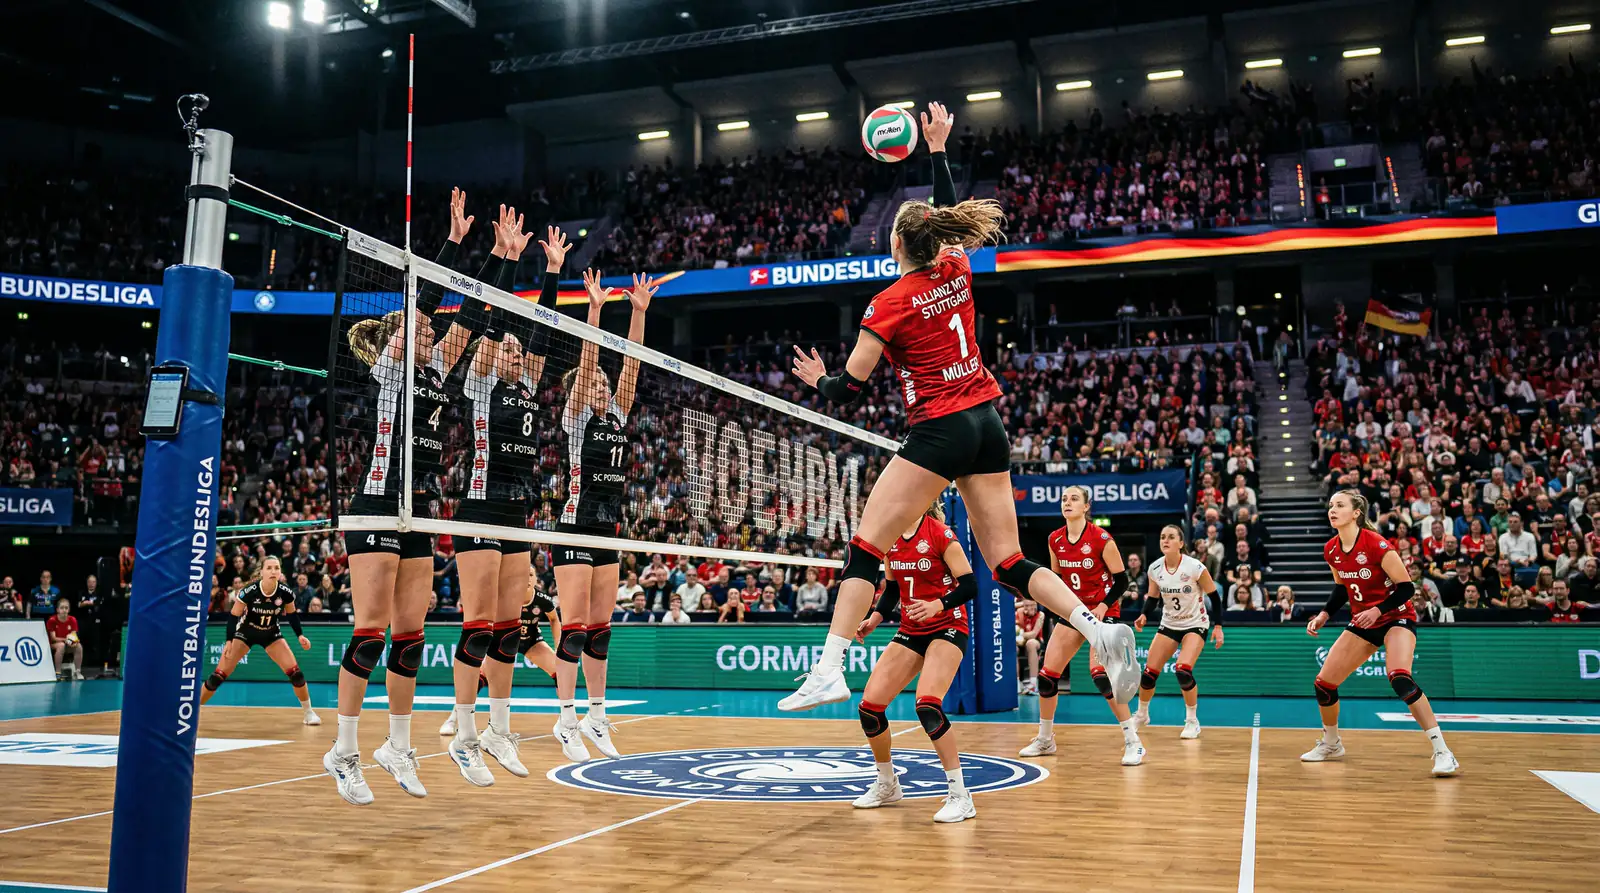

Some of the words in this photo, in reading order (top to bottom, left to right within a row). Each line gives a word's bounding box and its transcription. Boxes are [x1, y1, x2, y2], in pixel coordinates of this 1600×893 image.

[1578, 203, 1600, 223] G
[1, 276, 155, 306] BUNDESLIGA
[911, 283, 953, 308] ALLIANZ
[921, 288, 971, 319] STUTTGART
[949, 313, 969, 358] 1
[942, 357, 980, 382] MÜLLER
[502, 396, 516, 406] SC
[428, 405, 443, 431] 4
[522, 412, 533, 437] 8
[592, 431, 605, 441] SC
[501, 442, 513, 452] SC
[610, 445, 624, 468] 11
[592, 473, 603, 482] SC
[1032, 482, 1169, 503] BUDESLIGA
[188, 456, 214, 594] BUNDESLIGA
[366, 534, 376, 546] 4
[565, 550, 574, 560] 11
[904, 576, 914, 598] 7
[1070, 572, 1081, 590] 9
[1350, 583, 1363, 602] 3
[1171, 597, 1181, 610] 3
[260, 615, 272, 626] 11
[177, 600, 202, 736] VOLLEYBALL
[611, 769, 949, 793] BUNDESLIA
